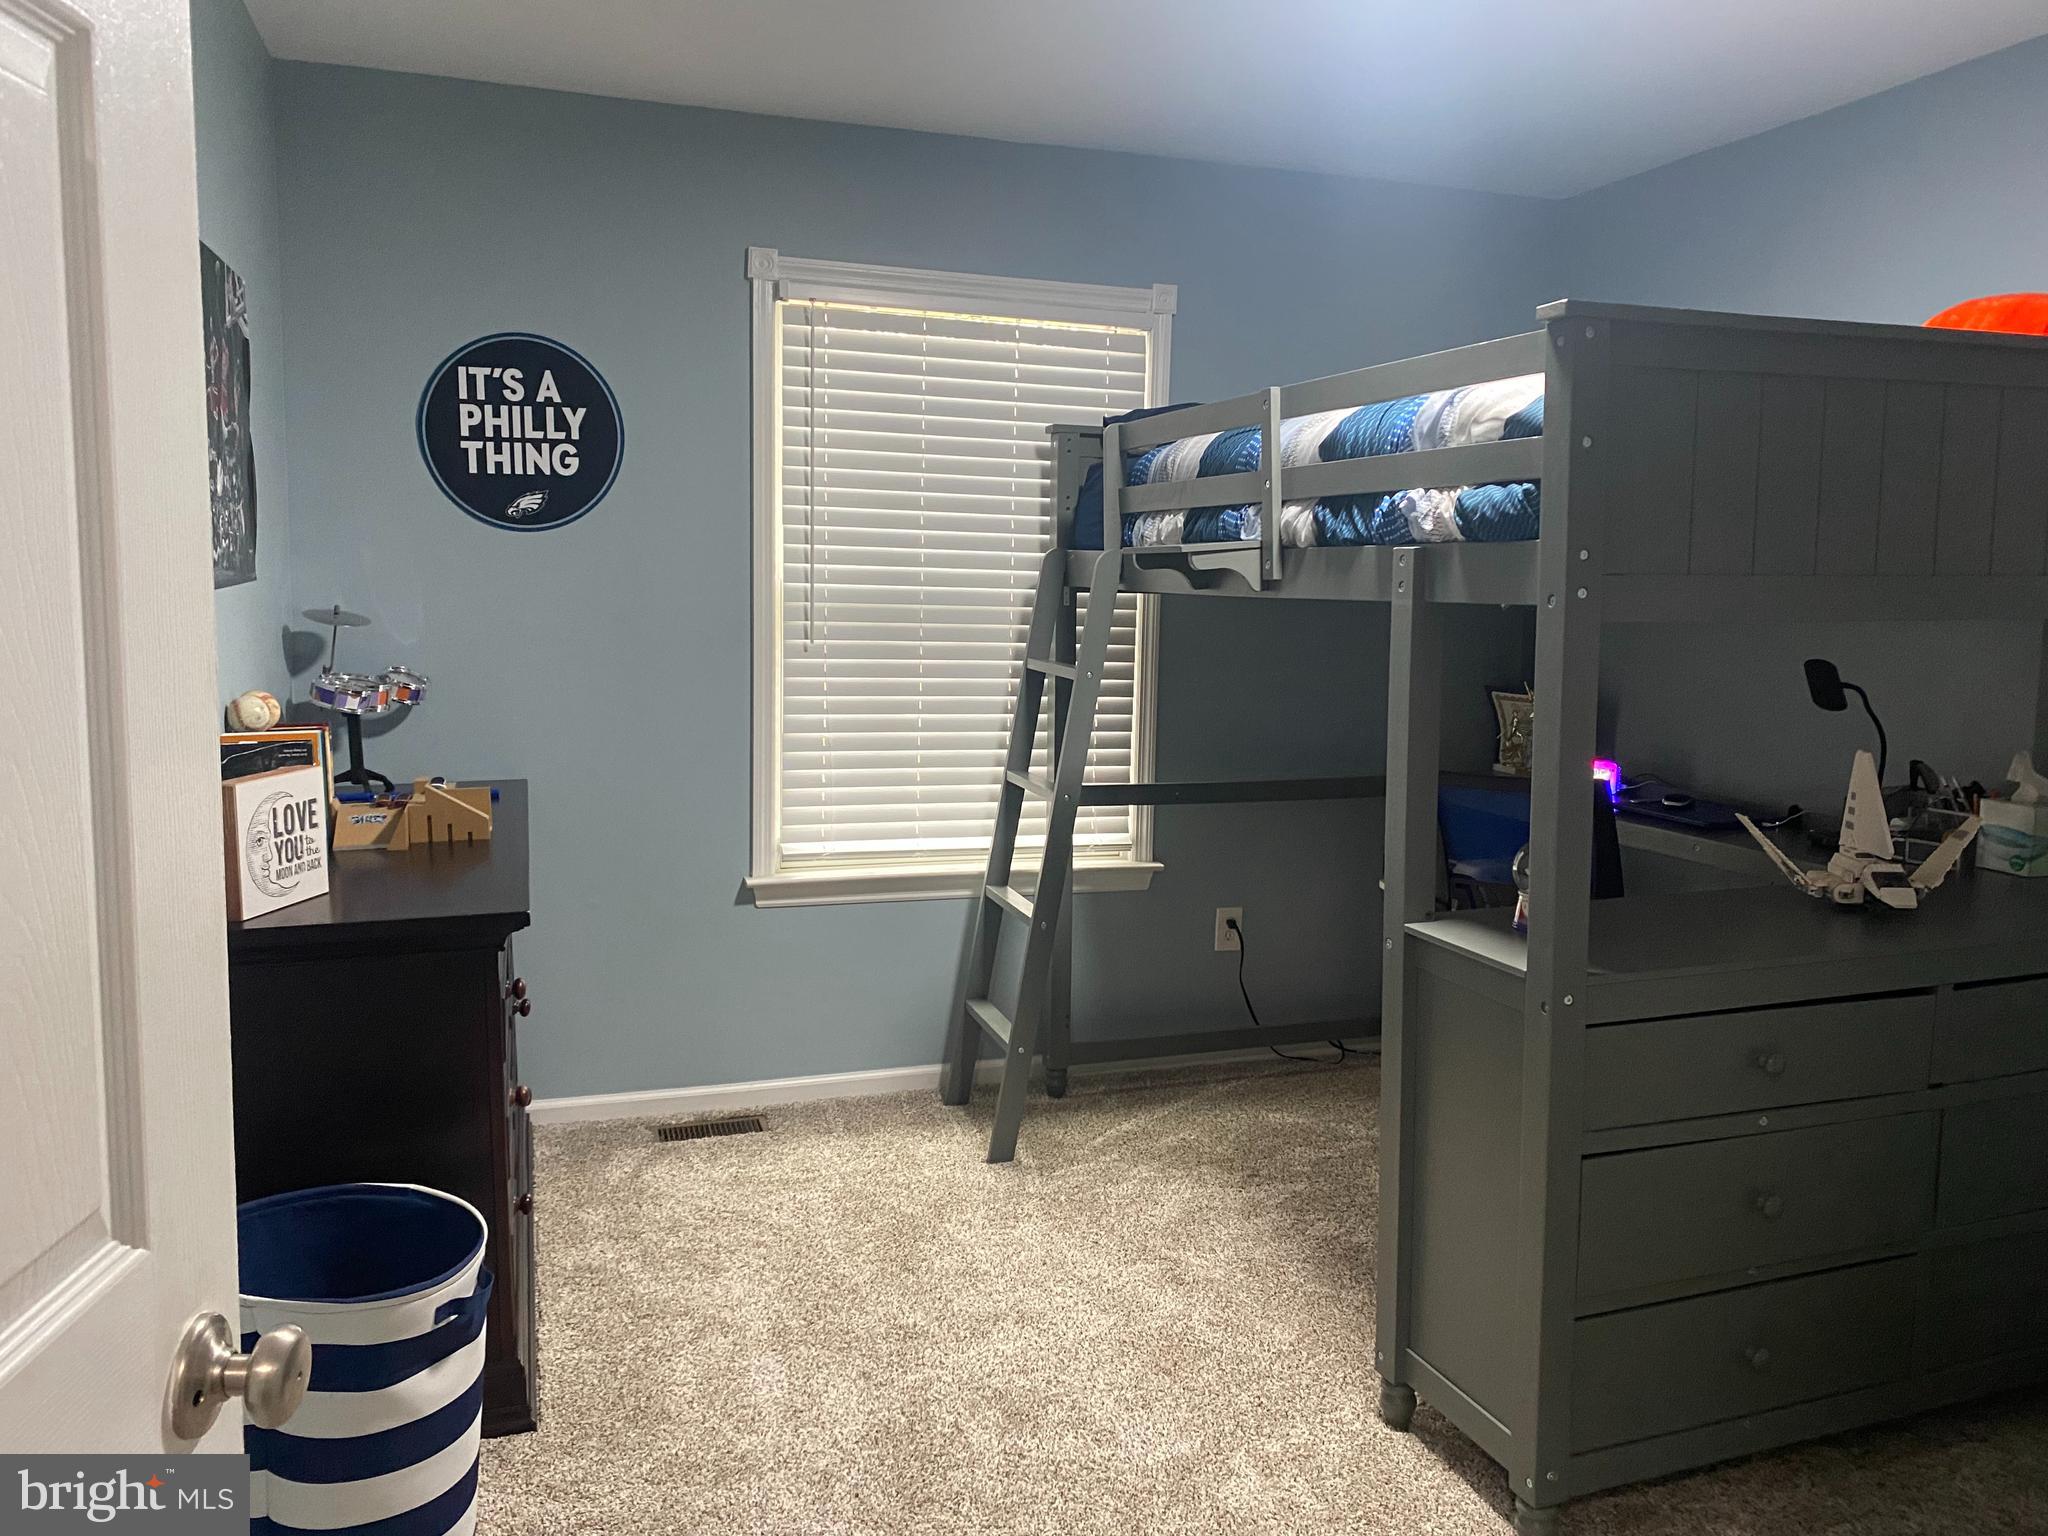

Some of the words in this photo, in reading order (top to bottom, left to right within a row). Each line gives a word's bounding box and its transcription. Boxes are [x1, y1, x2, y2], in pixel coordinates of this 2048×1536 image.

[457, 366, 525, 402] IT'S
[536, 369, 562, 403] A
[459, 403, 587, 440] PHILLY
[460, 440, 580, 476] THING
[272, 797, 319, 839] LOVE
[274, 834, 304, 866] YOU
[305, 835, 315, 845] to
[305, 845, 320, 857] the
[275, 866, 293, 881] MOON
[294, 861, 306, 875] AND
[306, 857, 322, 872] BACK
